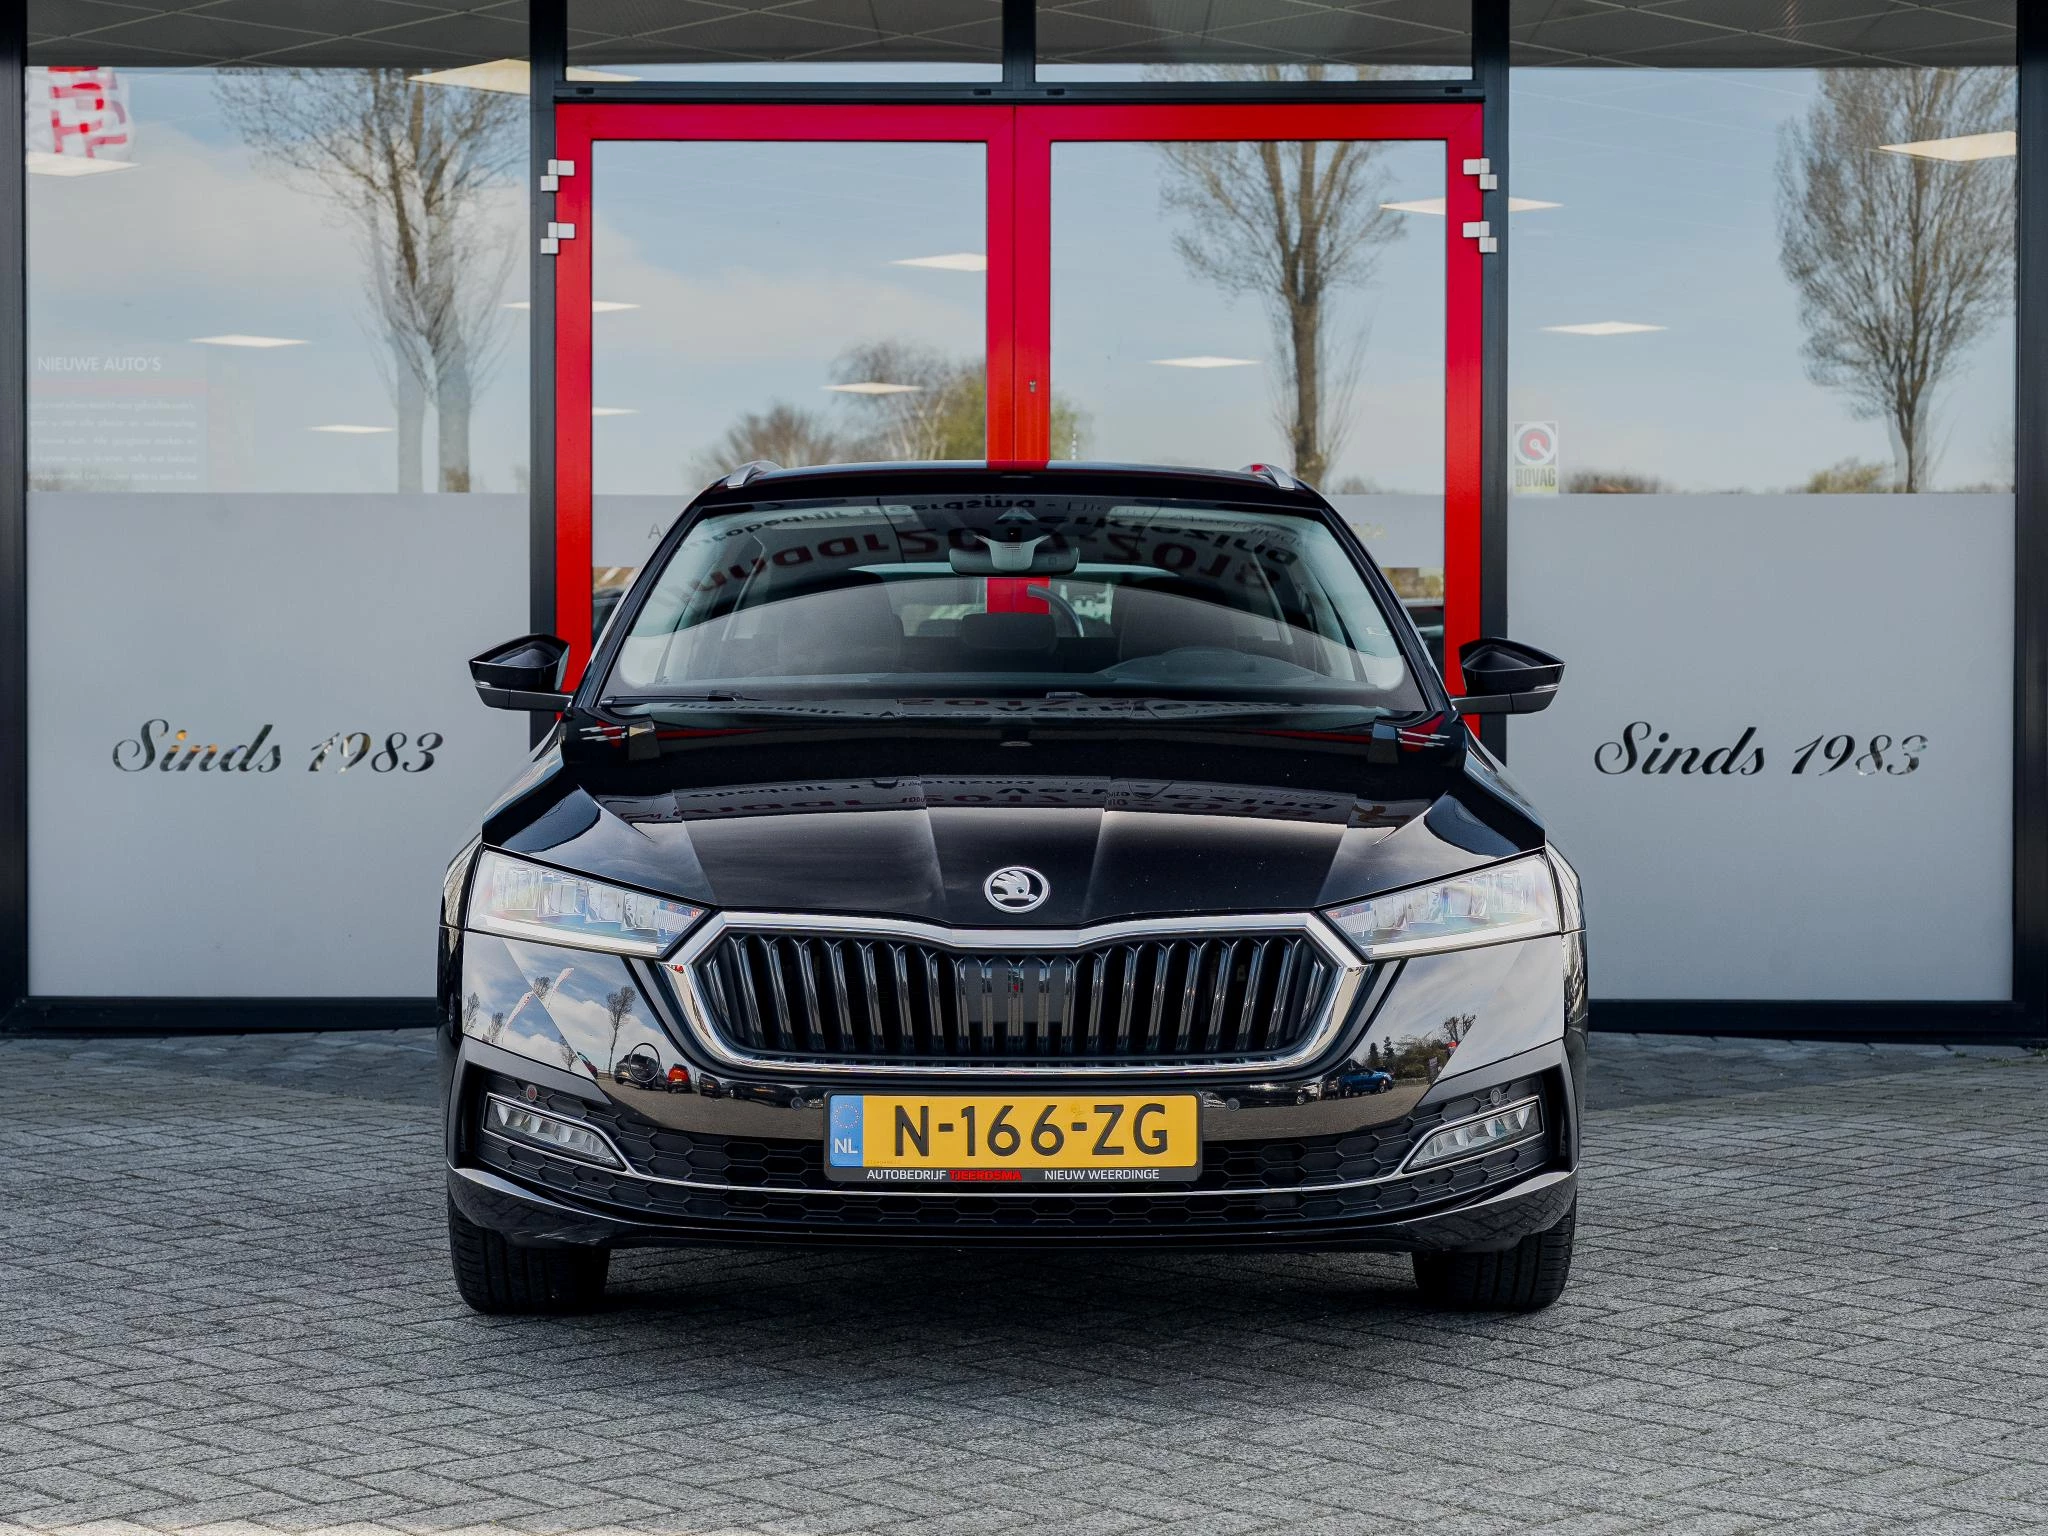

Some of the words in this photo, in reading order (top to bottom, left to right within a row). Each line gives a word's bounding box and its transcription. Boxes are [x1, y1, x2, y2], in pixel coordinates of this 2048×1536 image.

[37, 356, 99, 371] NIEUWE
[104, 356, 161, 371] AUTO'S
[1515, 468, 1556, 487] BOVAG
[112, 718, 281, 773] Sinds
[308, 732, 444, 774] 1983
[1593, 721, 1765, 775] Sinds
[1791, 734, 1929, 776] 1983
[895, 1103, 1168, 1157] N-166-ZG
[833, 1139, 858, 1154] NL
[866, 1169, 947, 1180] AUTOBEDRIJF
[949, 1169, 1023, 1181] TJEERDSMA
[1044, 1169, 1085, 1180] NIEUW
[1088, 1169, 1160, 1180] WEERDINGE
